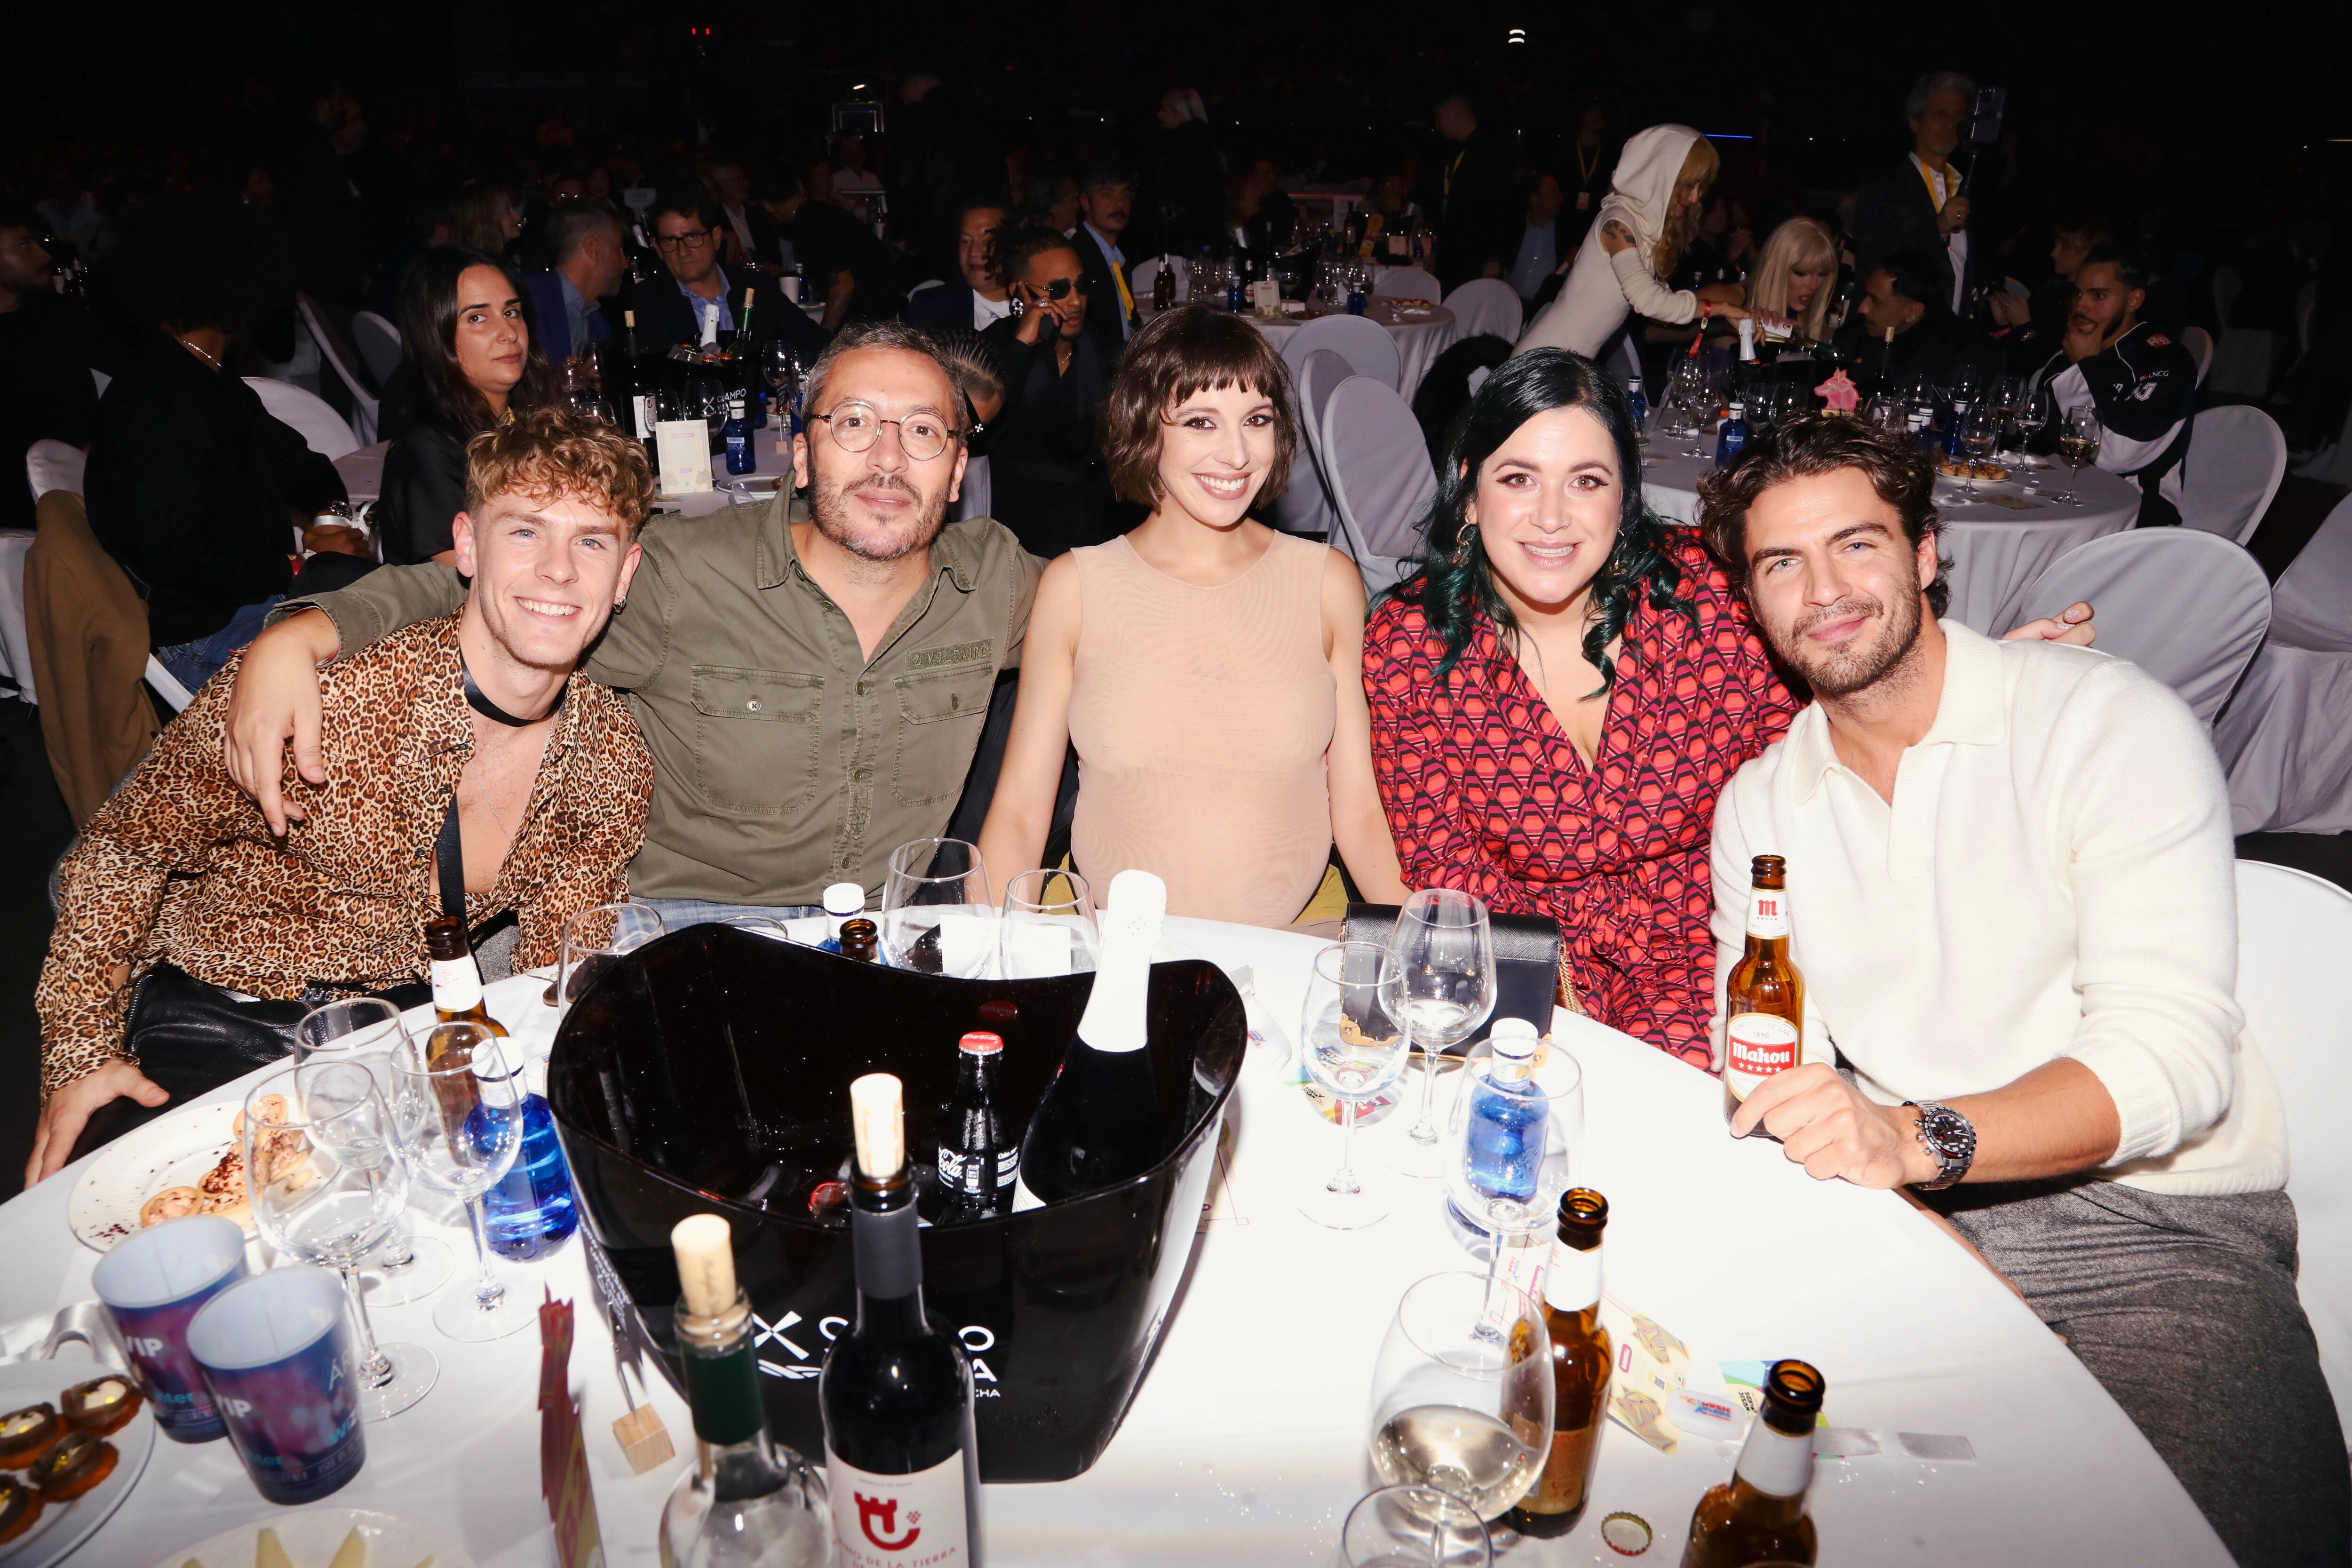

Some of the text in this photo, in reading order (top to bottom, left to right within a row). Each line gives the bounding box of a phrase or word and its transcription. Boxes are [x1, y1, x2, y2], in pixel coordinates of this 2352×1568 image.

[1734, 1021, 1751, 1031] CINCO
[1732, 1041, 1790, 1064] Mahou
[1701, 1401, 1732, 1413] MUSIC
[912, 1546, 956, 1568] TIERRA
